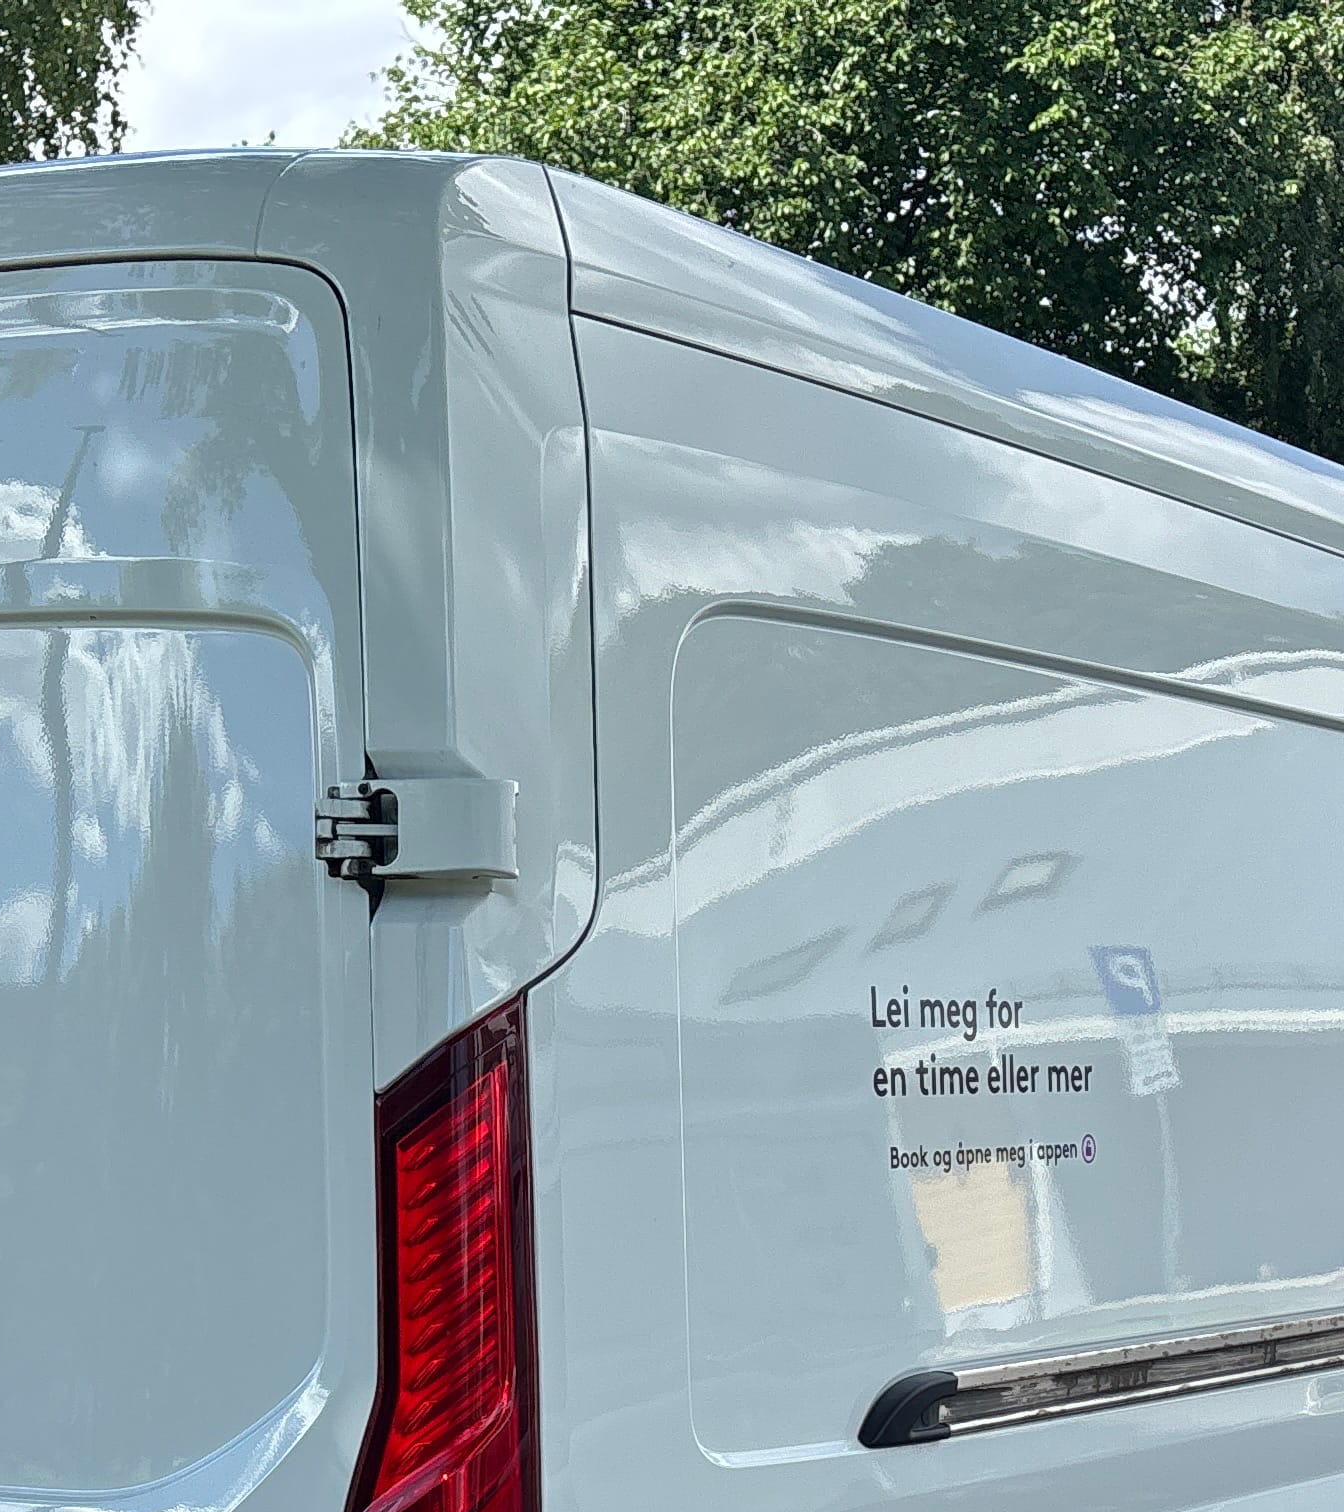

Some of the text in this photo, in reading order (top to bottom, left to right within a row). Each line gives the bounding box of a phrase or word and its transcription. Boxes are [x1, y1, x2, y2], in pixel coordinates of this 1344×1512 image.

[870, 984, 1023, 1042] Lei meg for
[873, 1053, 1093, 1097] en time eller mer
[890, 1138, 1078, 1173] Book og åpne meg i appen
